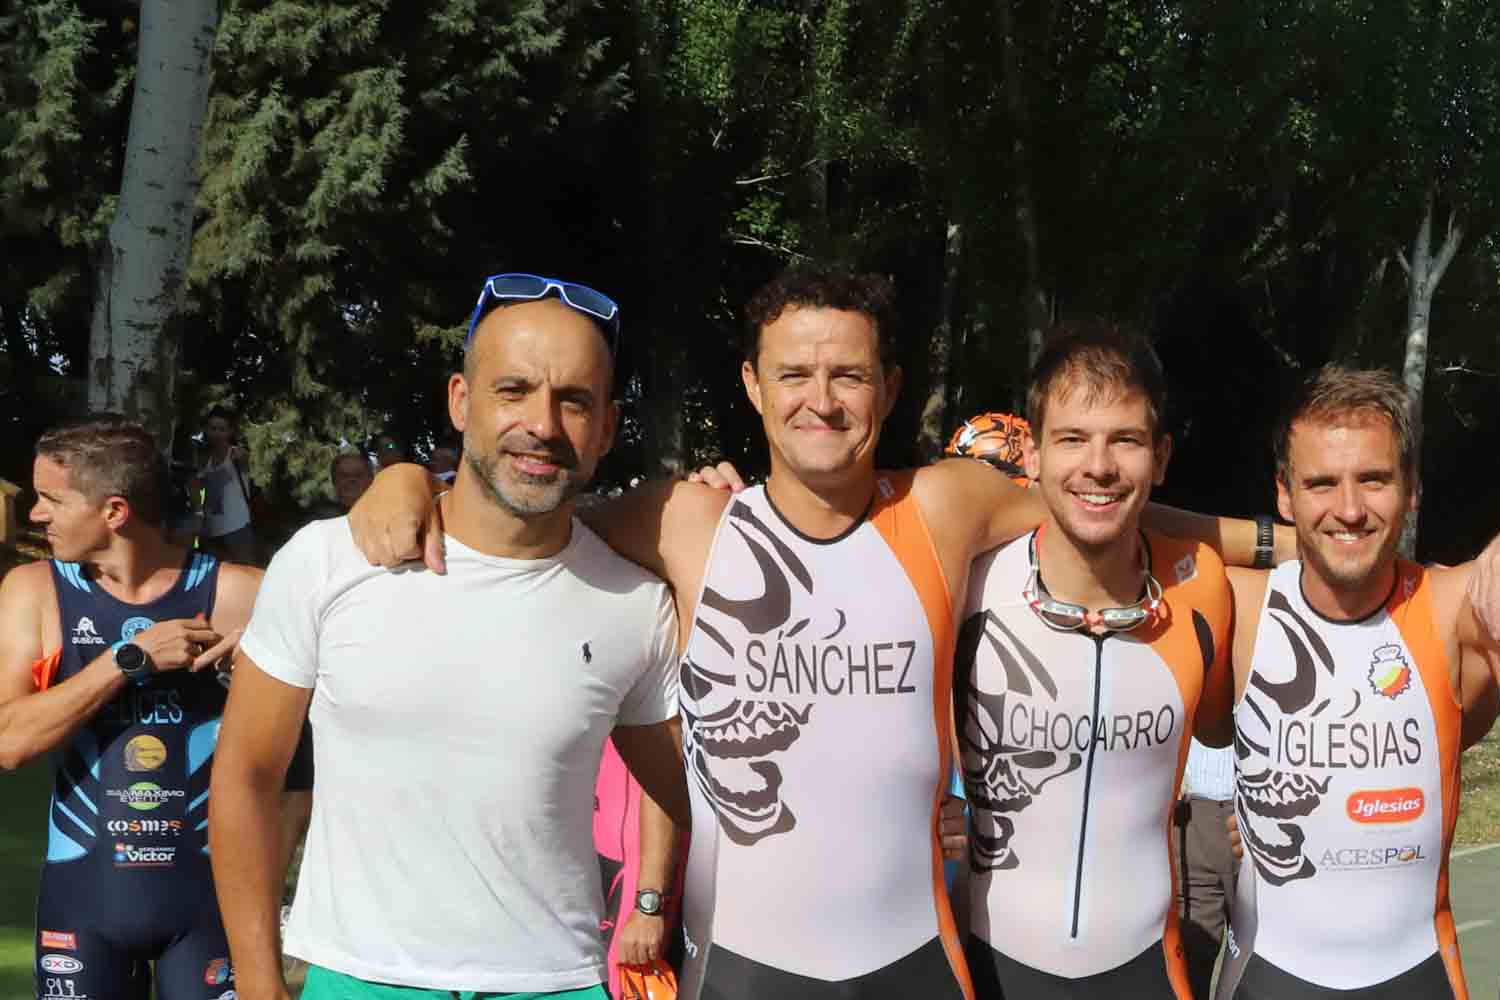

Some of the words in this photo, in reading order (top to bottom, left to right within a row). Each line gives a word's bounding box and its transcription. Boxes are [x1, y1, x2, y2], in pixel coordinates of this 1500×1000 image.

[746, 630, 916, 695] SÁNCHEZ
[1010, 703, 1175, 751] CHOCARRO
[1277, 718, 1422, 769] IGLESIAS
[127, 850, 175, 862] Victor
